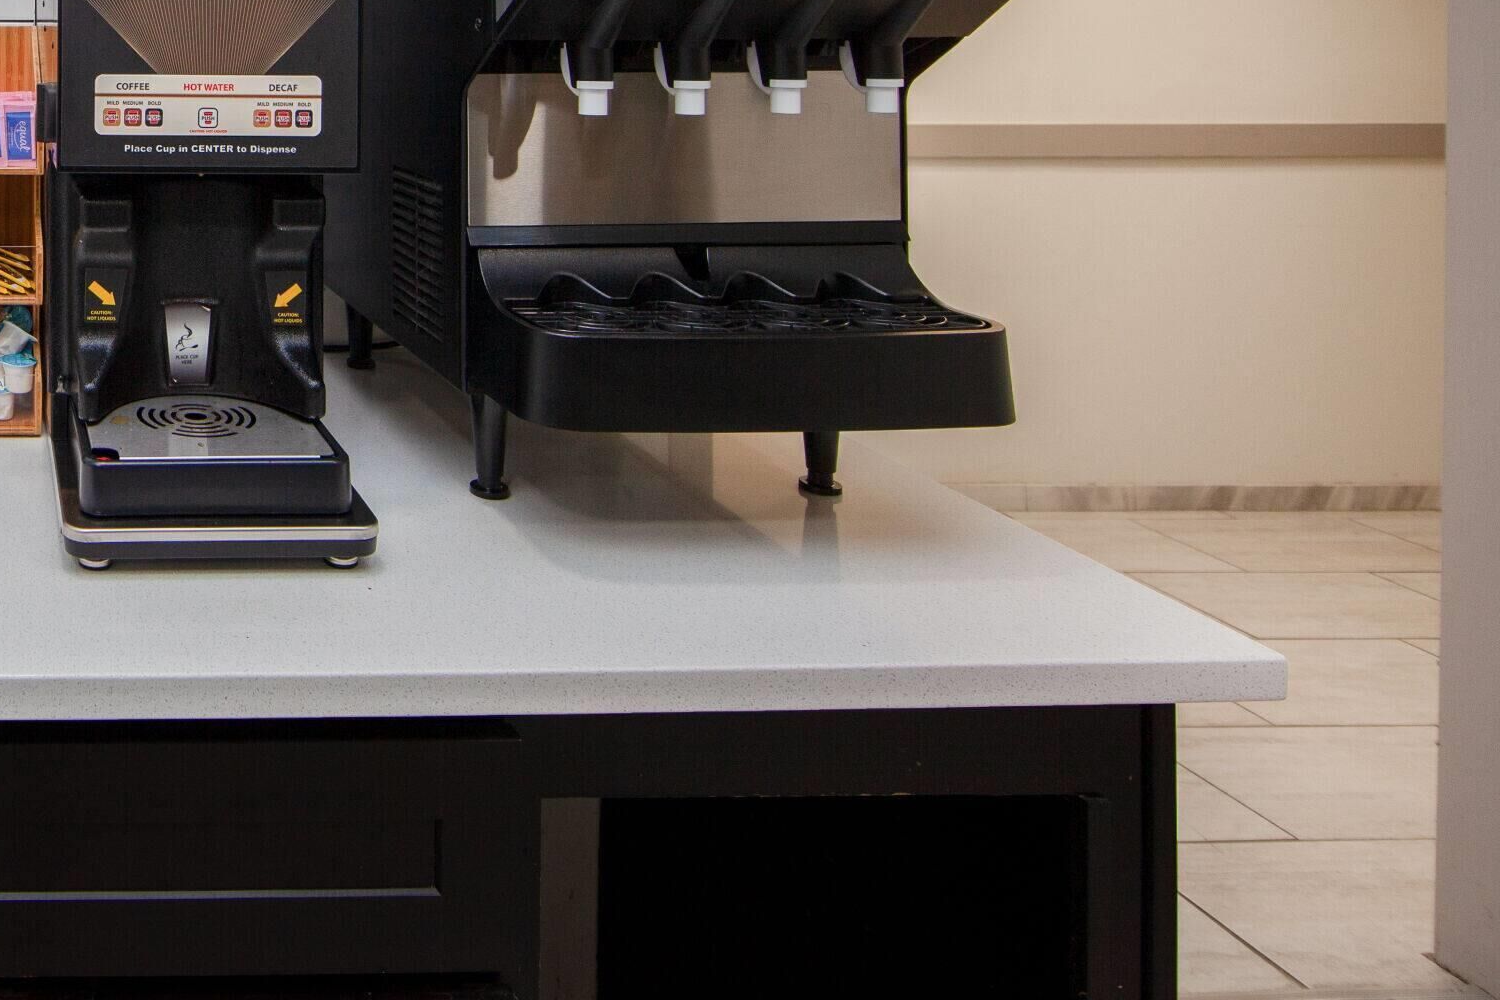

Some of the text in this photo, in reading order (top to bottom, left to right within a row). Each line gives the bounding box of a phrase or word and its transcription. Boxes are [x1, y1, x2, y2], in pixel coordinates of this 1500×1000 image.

[116, 82, 150, 91] COFFEE
[183, 83, 235, 92] HOT WATER
[268, 84, 298, 92] DECAF
[16, 120, 31, 152] equal
[124, 143, 298, 156] Place Cup in CENTER to Dispense
